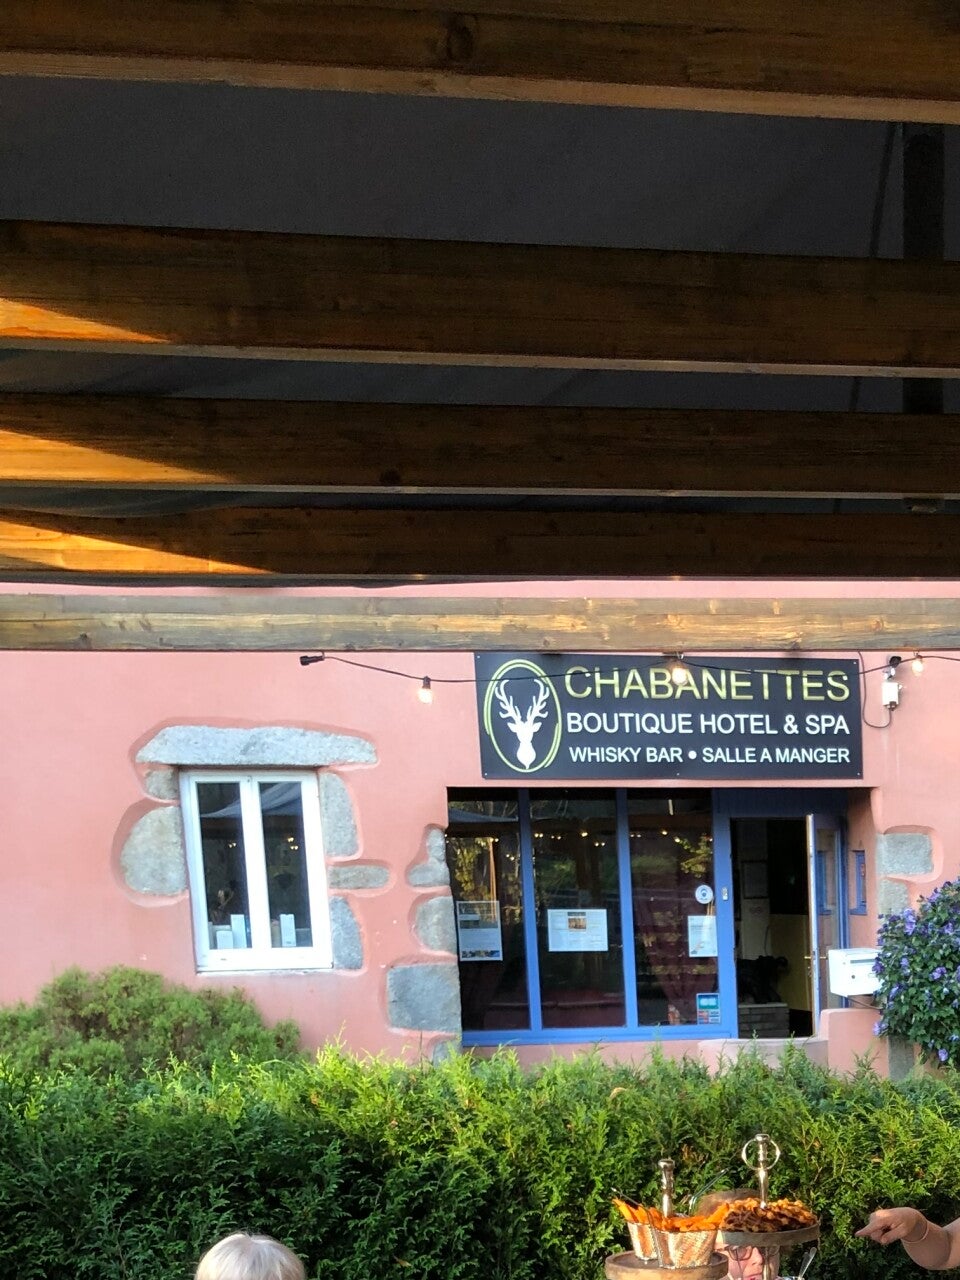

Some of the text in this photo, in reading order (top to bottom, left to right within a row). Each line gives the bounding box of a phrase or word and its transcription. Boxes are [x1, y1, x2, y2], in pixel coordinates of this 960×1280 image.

[565, 666, 850, 701] CHABANETTES
[566, 712, 851, 735] BOUTIQUE HOTEL & SPA
[568, 747, 851, 763] WHISKY BAR SALLE A MANGER
